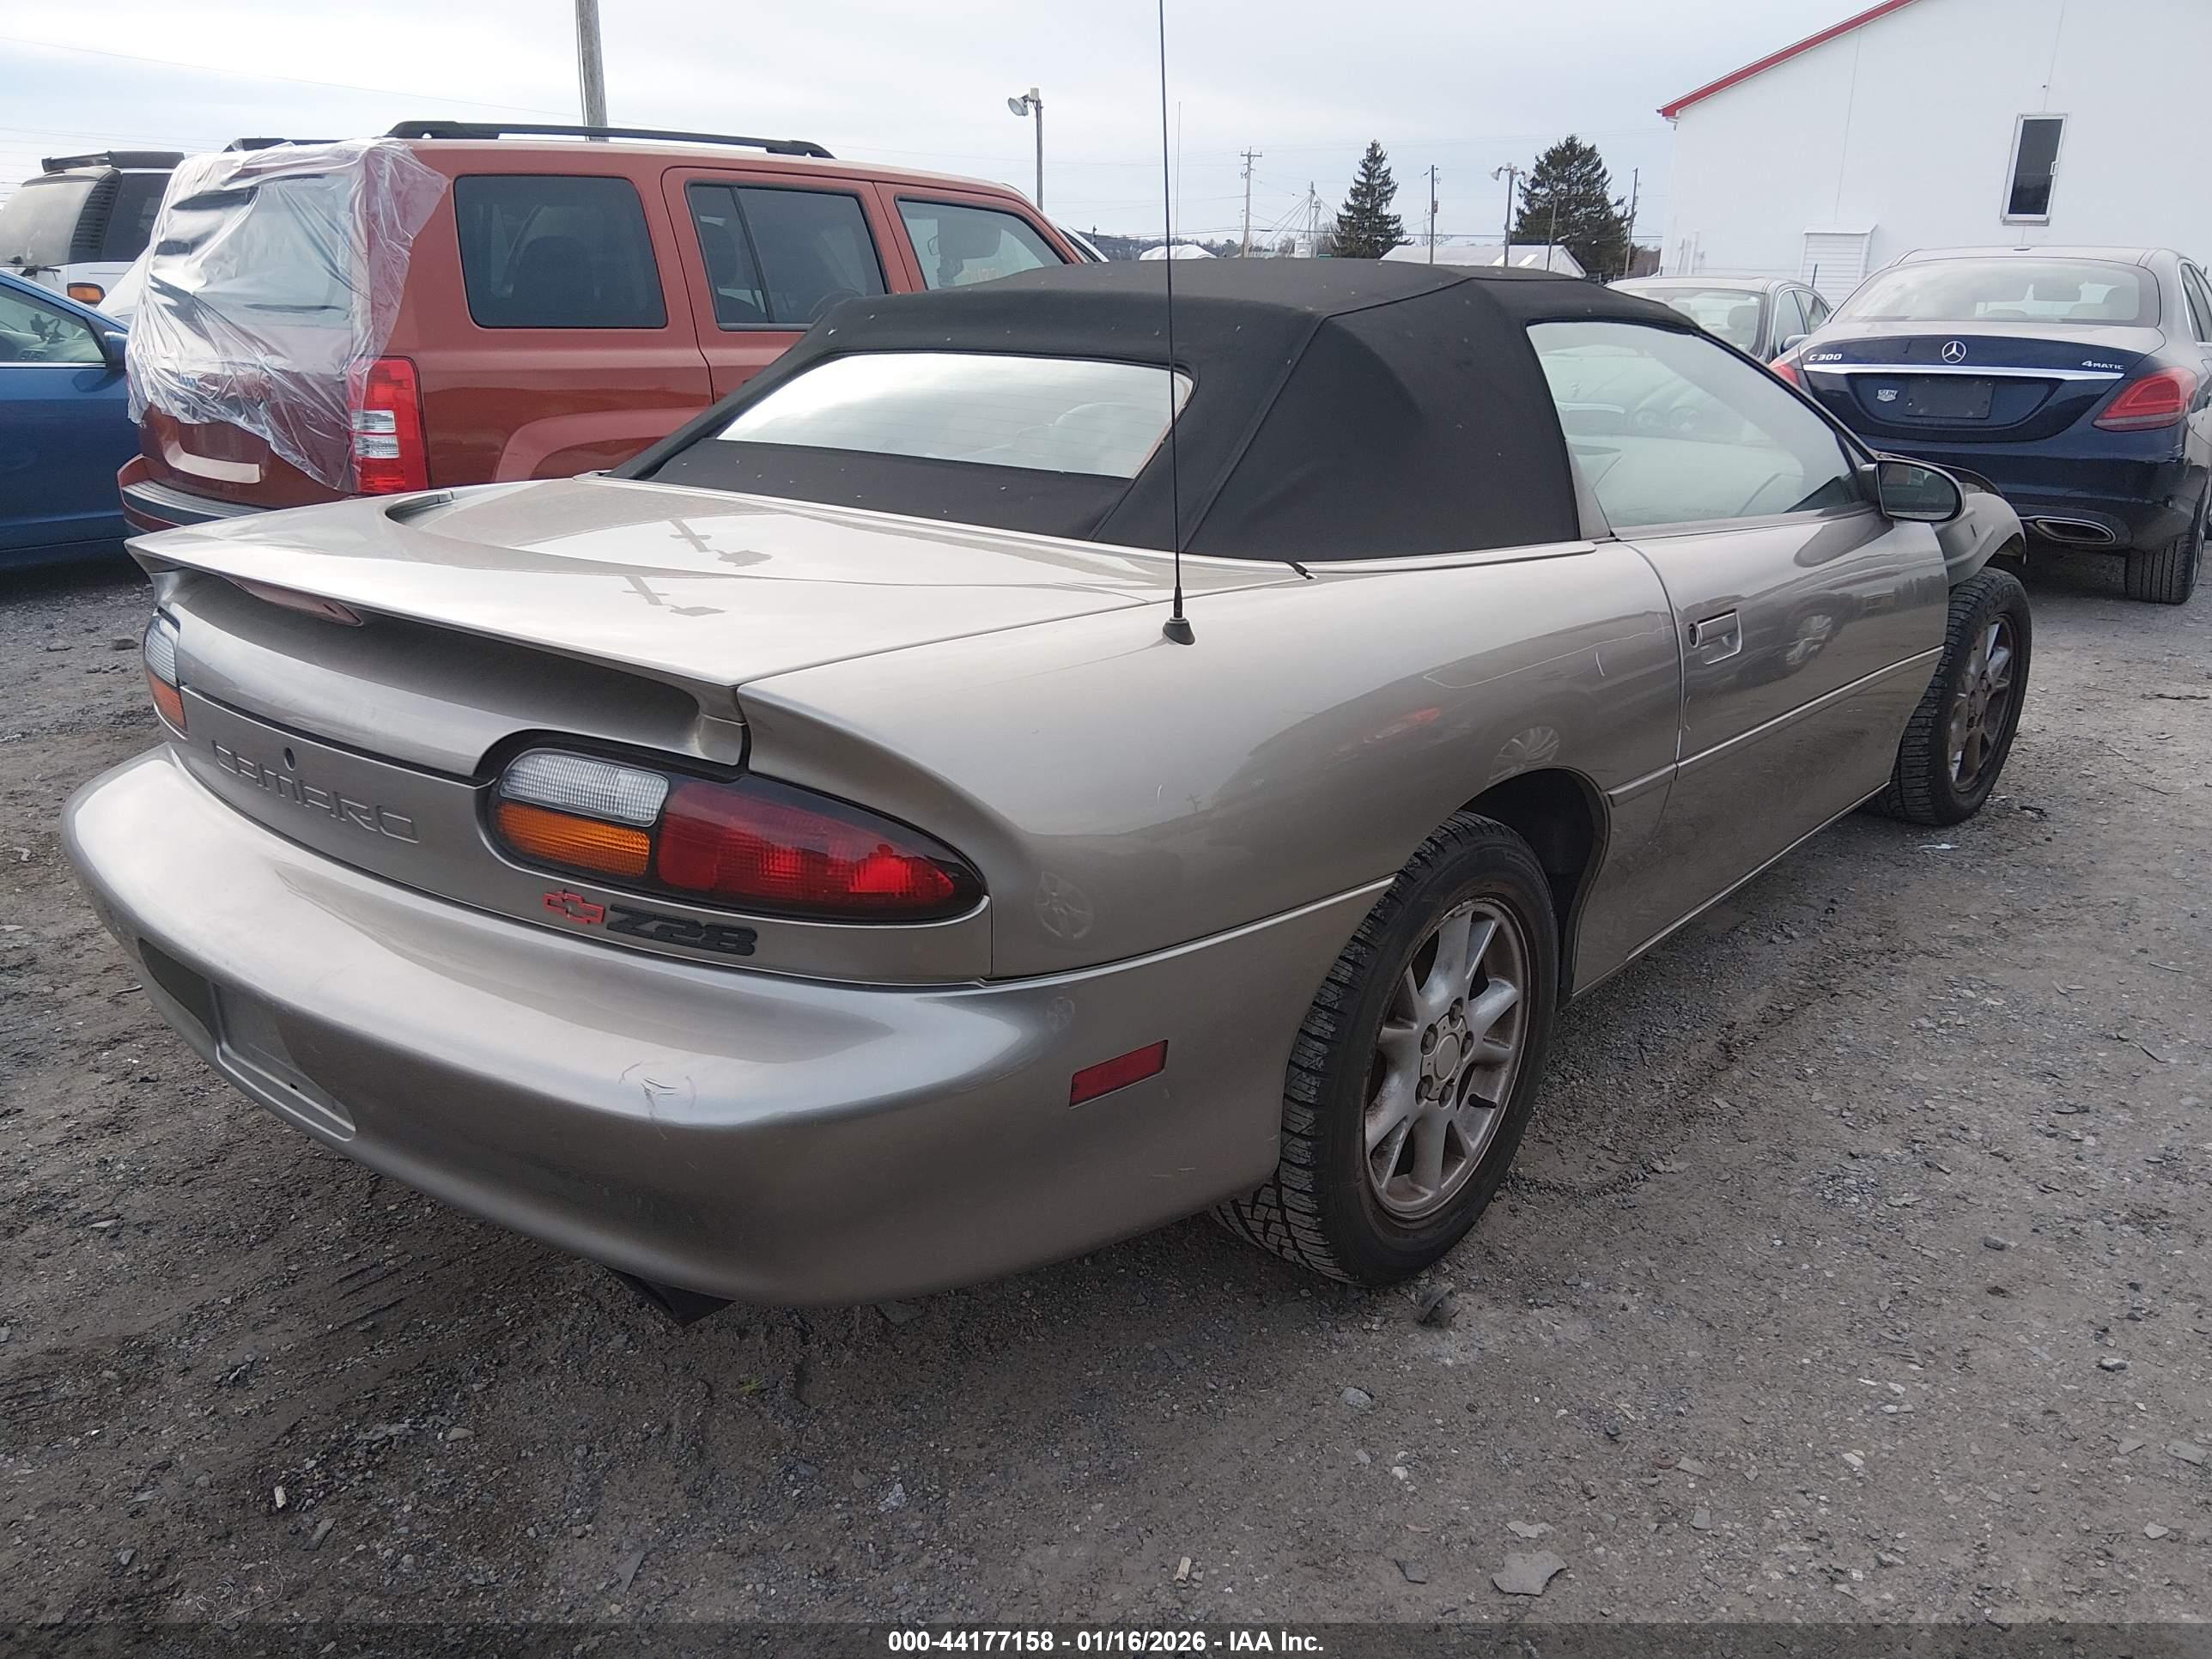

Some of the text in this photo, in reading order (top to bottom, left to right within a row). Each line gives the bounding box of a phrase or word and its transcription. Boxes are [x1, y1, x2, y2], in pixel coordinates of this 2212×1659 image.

[1818, 353, 1843, 362] 300
[2081, 360, 2125, 370] 4MATIC
[606, 904, 758, 957] Z28
